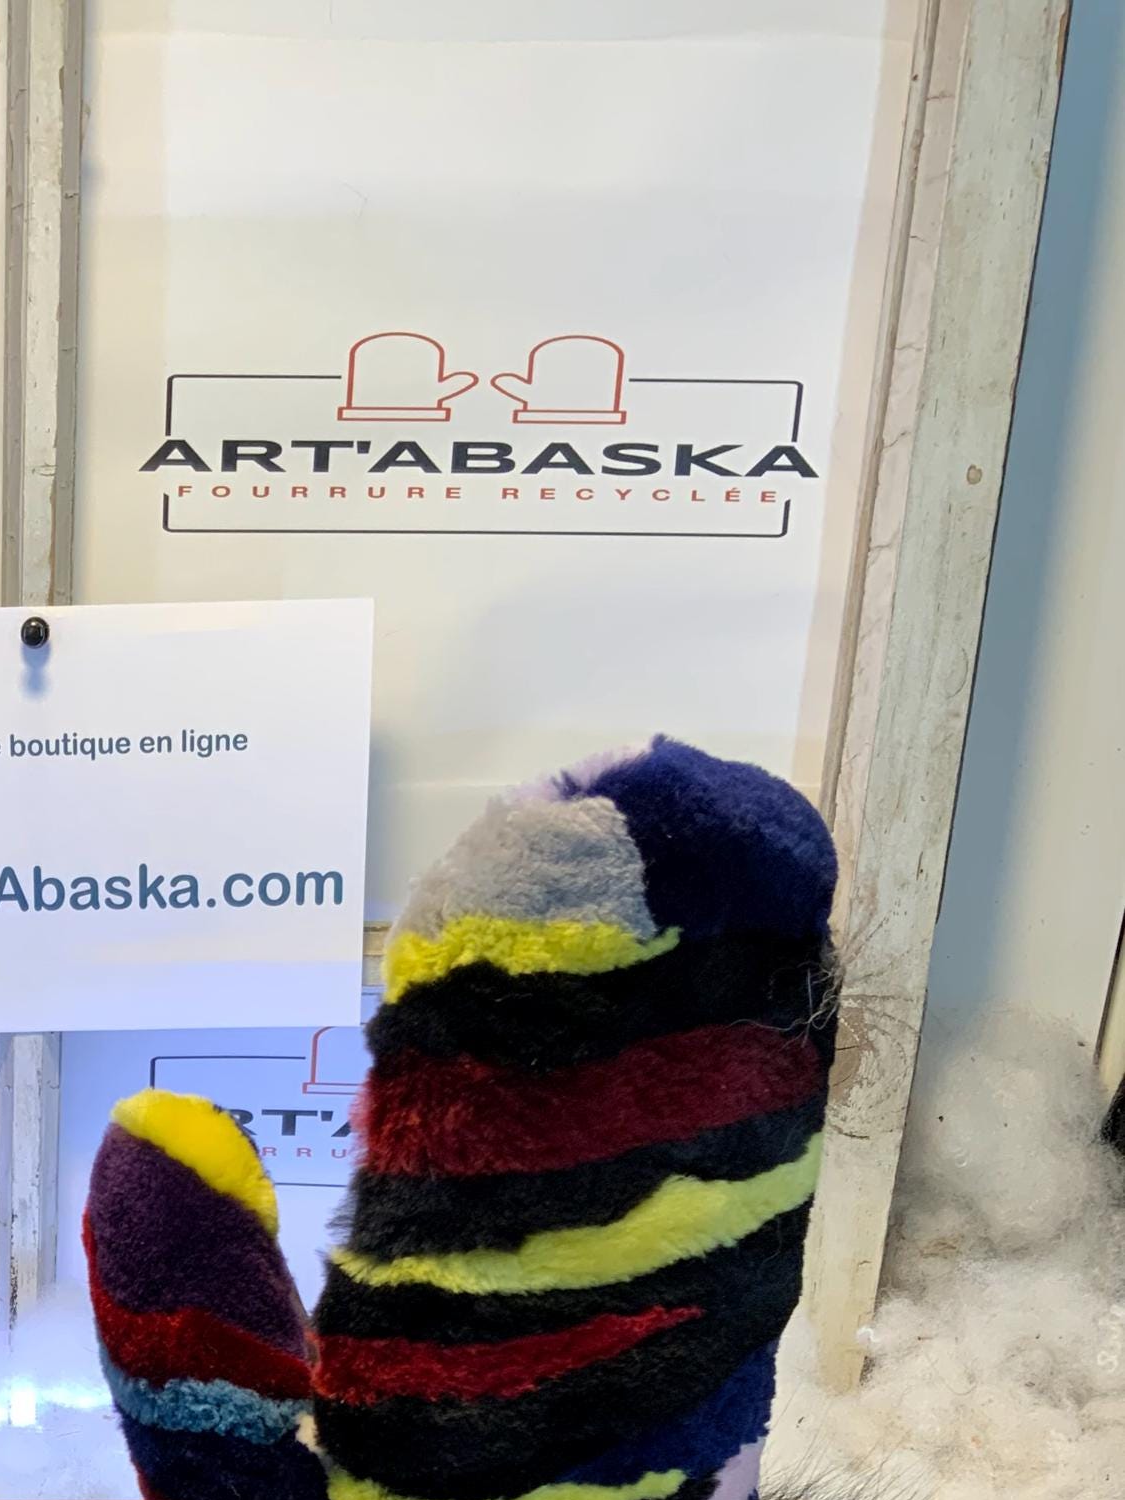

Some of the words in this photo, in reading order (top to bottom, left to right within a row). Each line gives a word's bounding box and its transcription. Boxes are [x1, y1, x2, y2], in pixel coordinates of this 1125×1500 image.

[138, 438, 820, 479] ART'ABASKA
[177, 484, 462, 500] FOURRURE
[501, 485, 778, 503] RECYCLÉE
[9, 732, 132, 762] boutique
[138, 733, 173, 755] en
[180, 729, 249, 760] ligne
